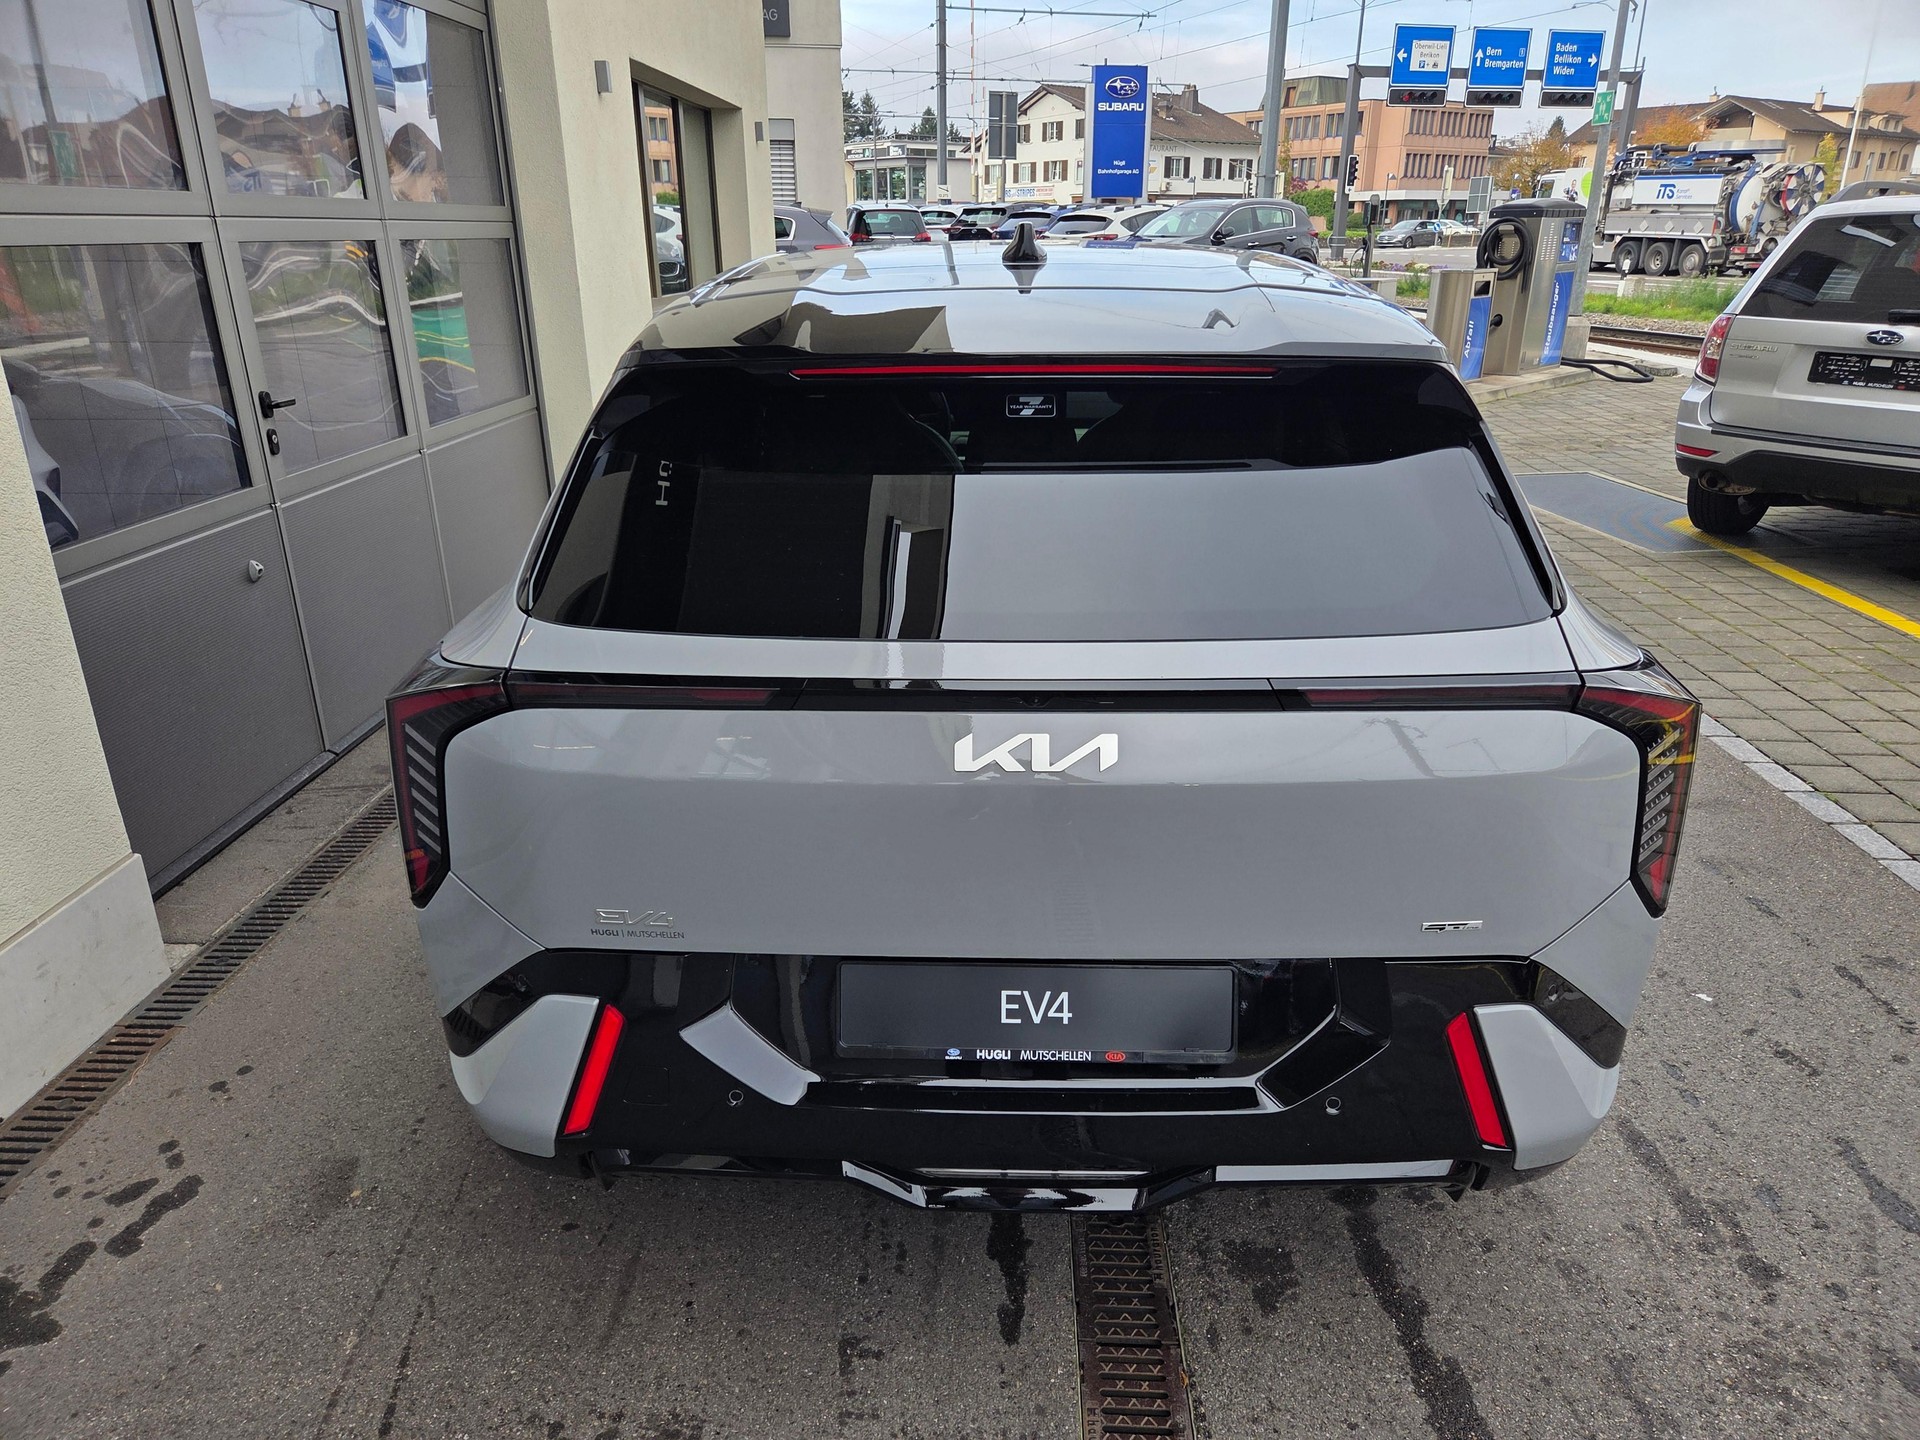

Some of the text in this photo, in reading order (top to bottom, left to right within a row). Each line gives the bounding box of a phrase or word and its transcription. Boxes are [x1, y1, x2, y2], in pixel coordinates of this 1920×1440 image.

[1486, 46, 1502, 56] Bern
[1555, 42, 1578, 52] Baden
[1484, 58, 1524, 70] Bremgarten
[1553, 54, 1582, 64] Bellikon
[1553, 65, 1575, 75] Widen
[1097, 102, 1144, 112] SUBARU
[1543, 281, 1560, 354] Staubsauger
[1463, 320, 1475, 358] Abfall
[1730, 342, 1779, 352] SUBARU
[954, 733, 1119, 773] KIA
[594, 908, 674, 927] EV4
[626, 930, 685, 939] MUTSCHELLEN
[1000, 989, 1073, 1025] EV4
[1020, 1050, 1092, 1061] MUTSCHELLEN
[1108, 1052, 1123, 1061] KIA
